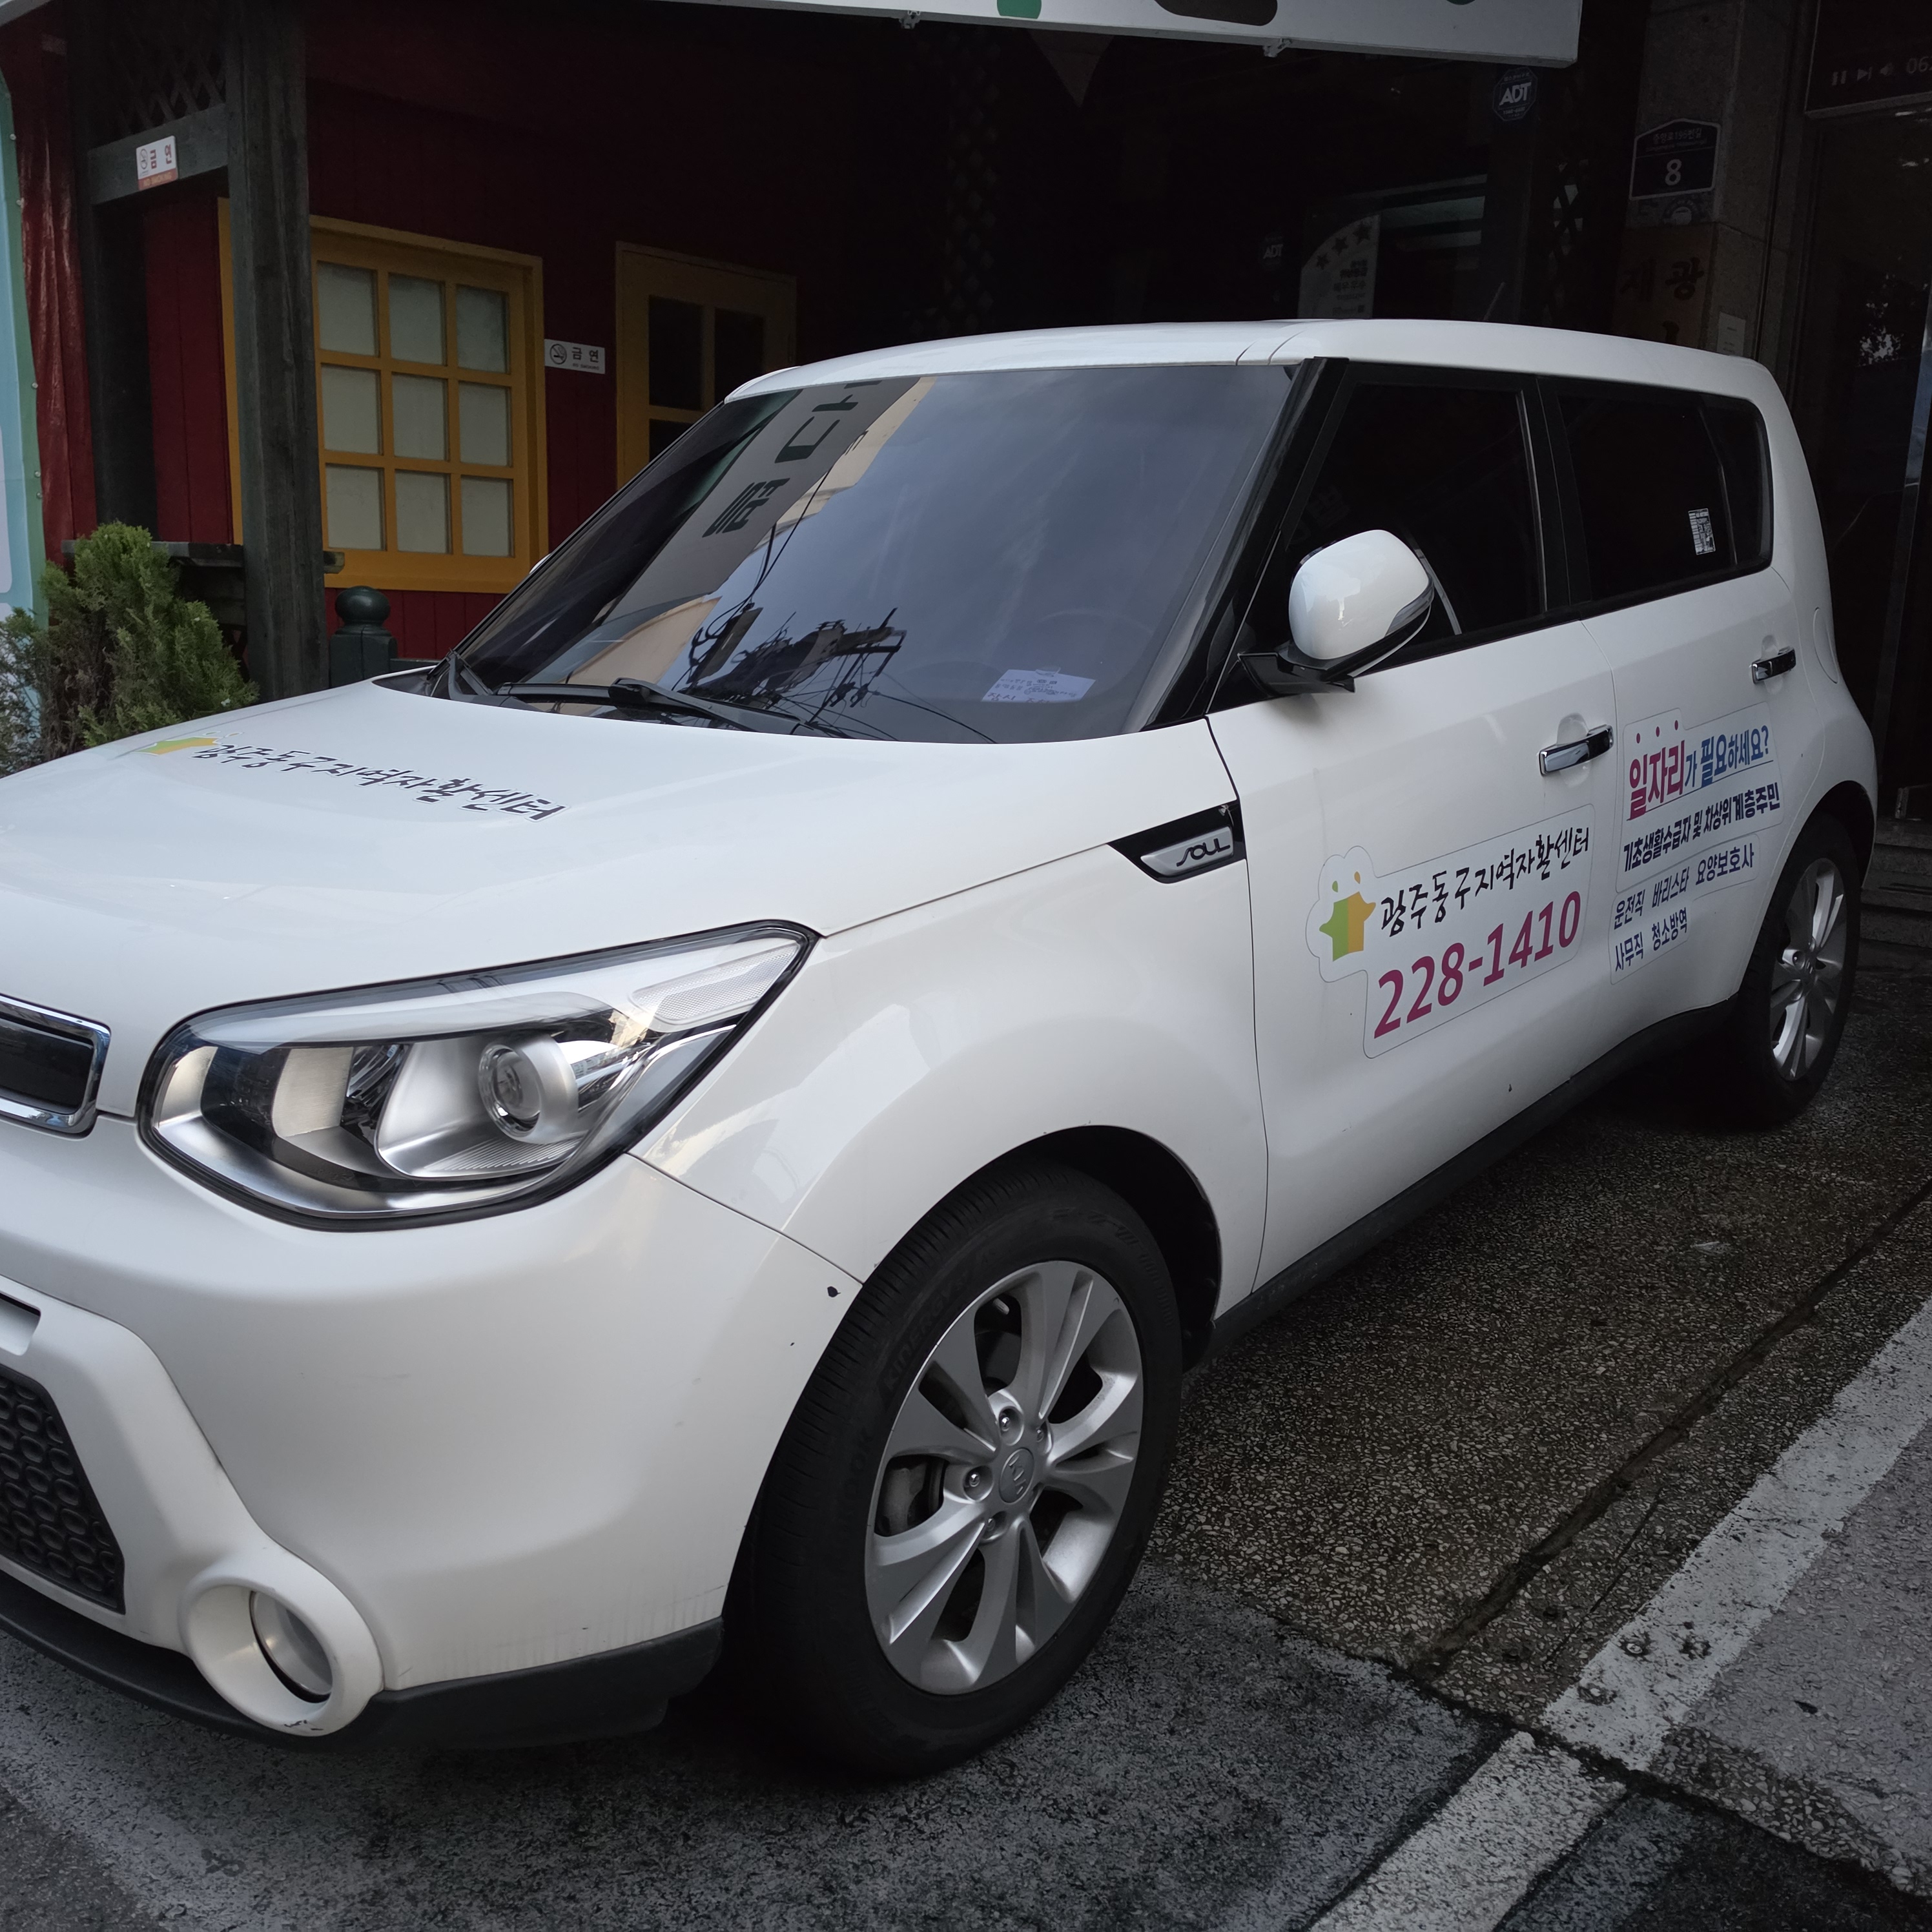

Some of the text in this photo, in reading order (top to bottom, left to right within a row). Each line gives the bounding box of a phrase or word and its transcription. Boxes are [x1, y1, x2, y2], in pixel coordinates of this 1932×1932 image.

[1499, 82, 1532, 105] ADT
[1907, 56, 1932, 74] 06
[1665, 159, 1682, 185] 8
[1263, 244, 1284, 259] ADT
[192, 744, 566, 821] 광주동구지역자활센터
[1629, 724, 1770, 820] 일자리가 필요하세요?
[1623, 814, 1692, 872] 기초생활수급자
[1692, 810, 1703, 840] 및
[1381, 827, 1589, 937] 광주동구지역자활센터
[1614, 843, 1755, 930] 운전직 바리스타 요양보호사
[1373, 890, 1581, 1039] 228-1410
[1614, 907, 1687, 972] 사무직 청소방역
